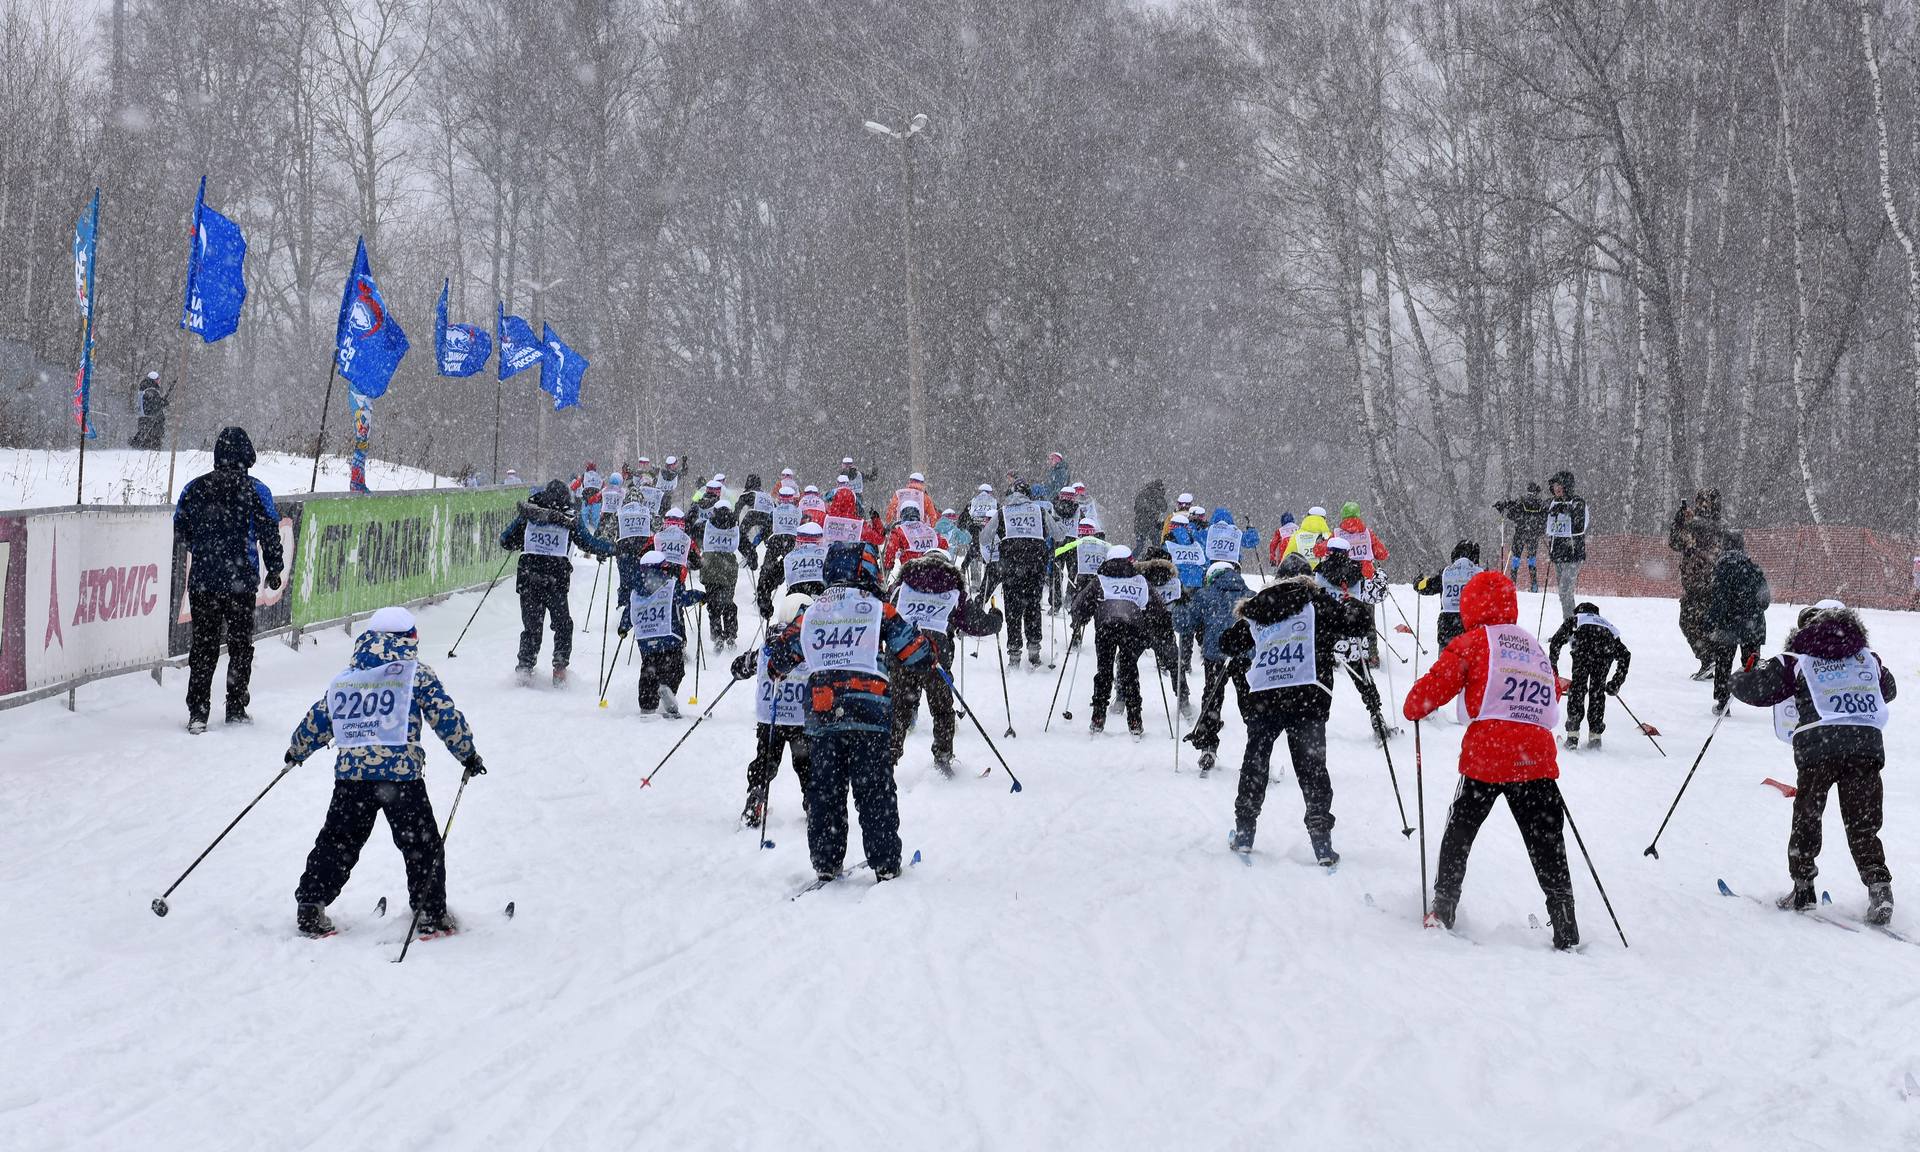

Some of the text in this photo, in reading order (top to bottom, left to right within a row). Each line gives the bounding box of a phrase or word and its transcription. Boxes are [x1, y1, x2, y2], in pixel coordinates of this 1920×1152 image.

[624, 517, 646, 528] 2737
[1009, 516, 1036, 527] 3243
[530, 531, 560, 548] 2834
[1211, 539, 1235, 552] 2878
[1175, 550, 1200, 561] 2205
[791, 557, 824, 572] 2449
[71, 562, 158, 627] ATOMIC
[1112, 585, 1142, 597] 2407
[811, 625, 868, 651] 3447
[1497, 632, 1530, 647] ЛЫЖНЯ
[1498, 640, 1531, 654] РОССИИ
[821, 650, 854, 661] БРЯНСКАЯ
[1255, 642, 1305, 669] 2844
[823, 658, 851, 668] ОБЛАСТЬ
[1813, 662, 1846, 675] РОССИИ
[1266, 666, 1296, 676] БРЯНСКАЯ
[1268, 673, 1294, 682] ОБЛАСТЬ
[1501, 676, 1551, 707] 2129
[332, 689, 395, 720] 2209
[1508, 704, 1544, 715] БРЯНСКАЯ
[1509, 711, 1540, 722] ОБЛАСТЬ
[344, 729, 377, 739] ОБЛАСТЬ
